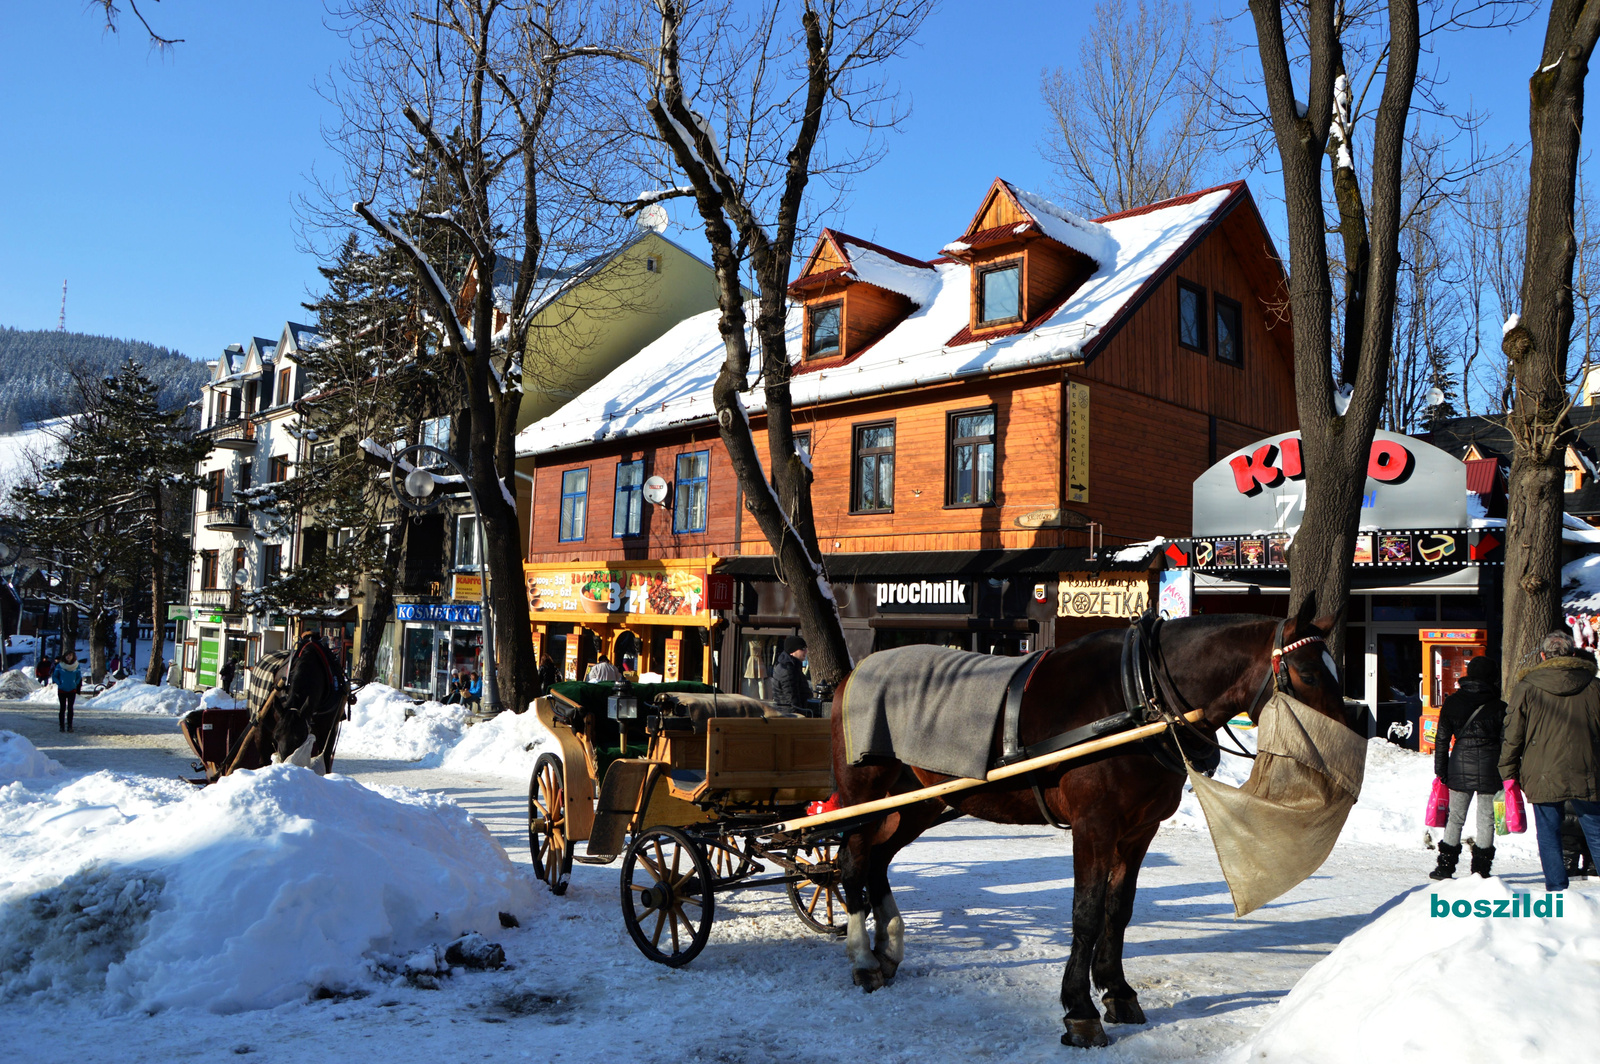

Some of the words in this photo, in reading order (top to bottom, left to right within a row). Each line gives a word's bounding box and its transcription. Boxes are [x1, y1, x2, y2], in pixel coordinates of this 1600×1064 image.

[1070, 383, 1078, 481] RESTAURACJA
[1229, 438, 1413, 496] KIO
[457, 577, 483, 585] KANTO
[537, 577, 549, 586] 100g
[619, 570, 664, 590] JADŁO
[540, 588, 554, 597] 200g
[1061, 591, 1145, 615] ROZETKA
[398, 606, 478, 620] KOSMETYKI
